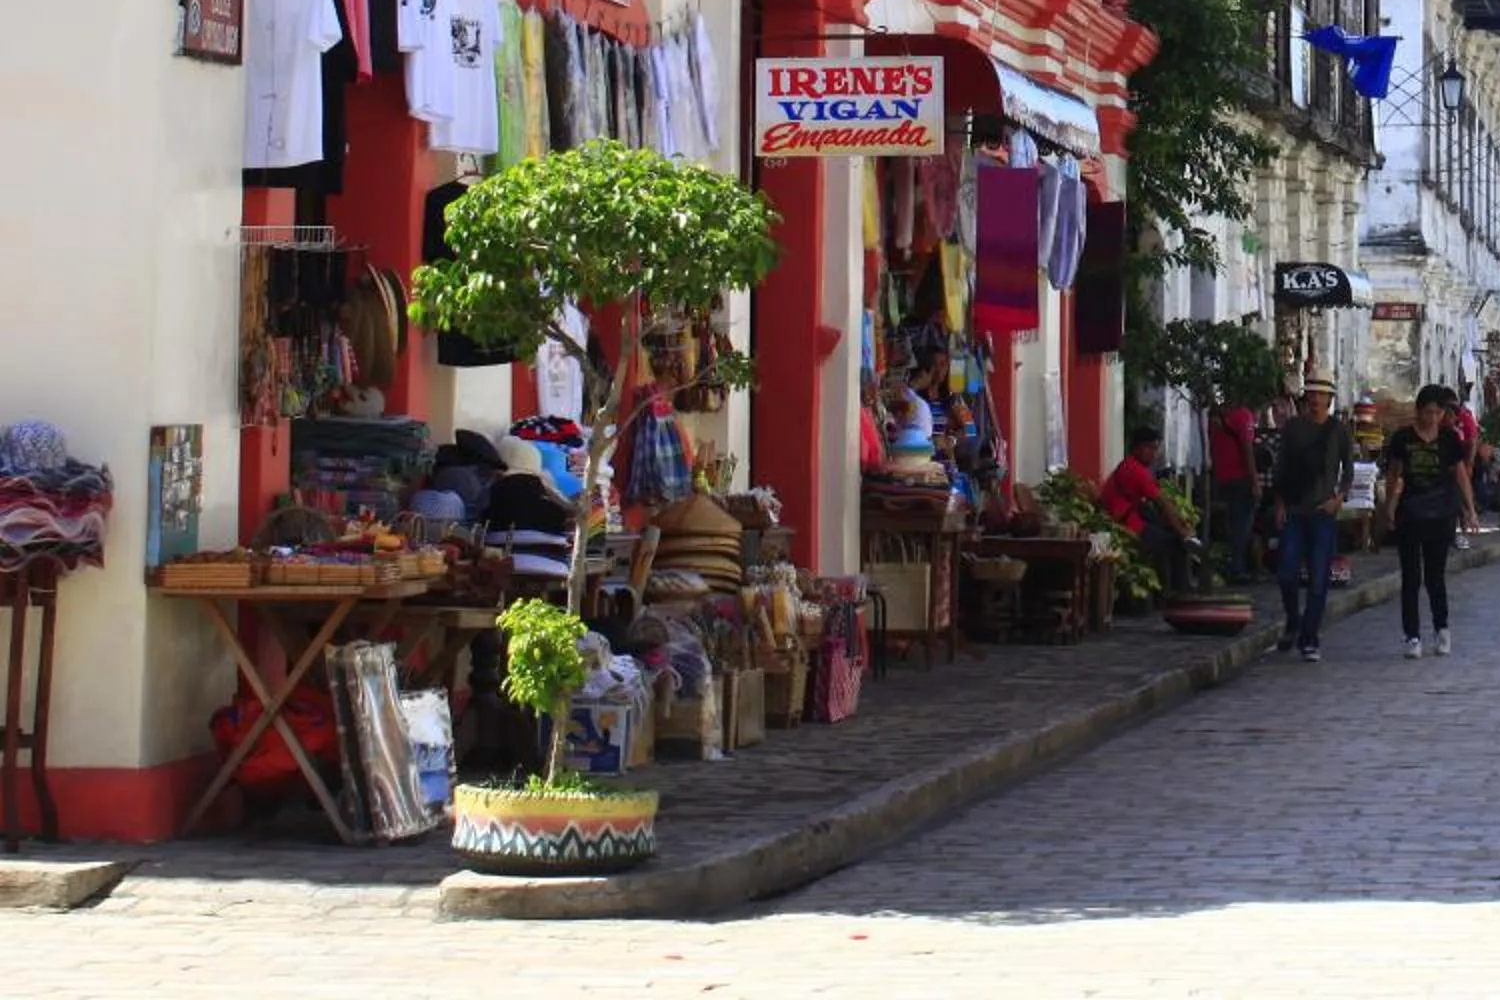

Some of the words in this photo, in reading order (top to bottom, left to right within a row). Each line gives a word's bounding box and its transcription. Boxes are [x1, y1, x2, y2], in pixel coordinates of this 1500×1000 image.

[768, 64, 933, 98] IRENE'S
[777, 98, 923, 121] VIGAN
[761, 119, 932, 153] Empanada
